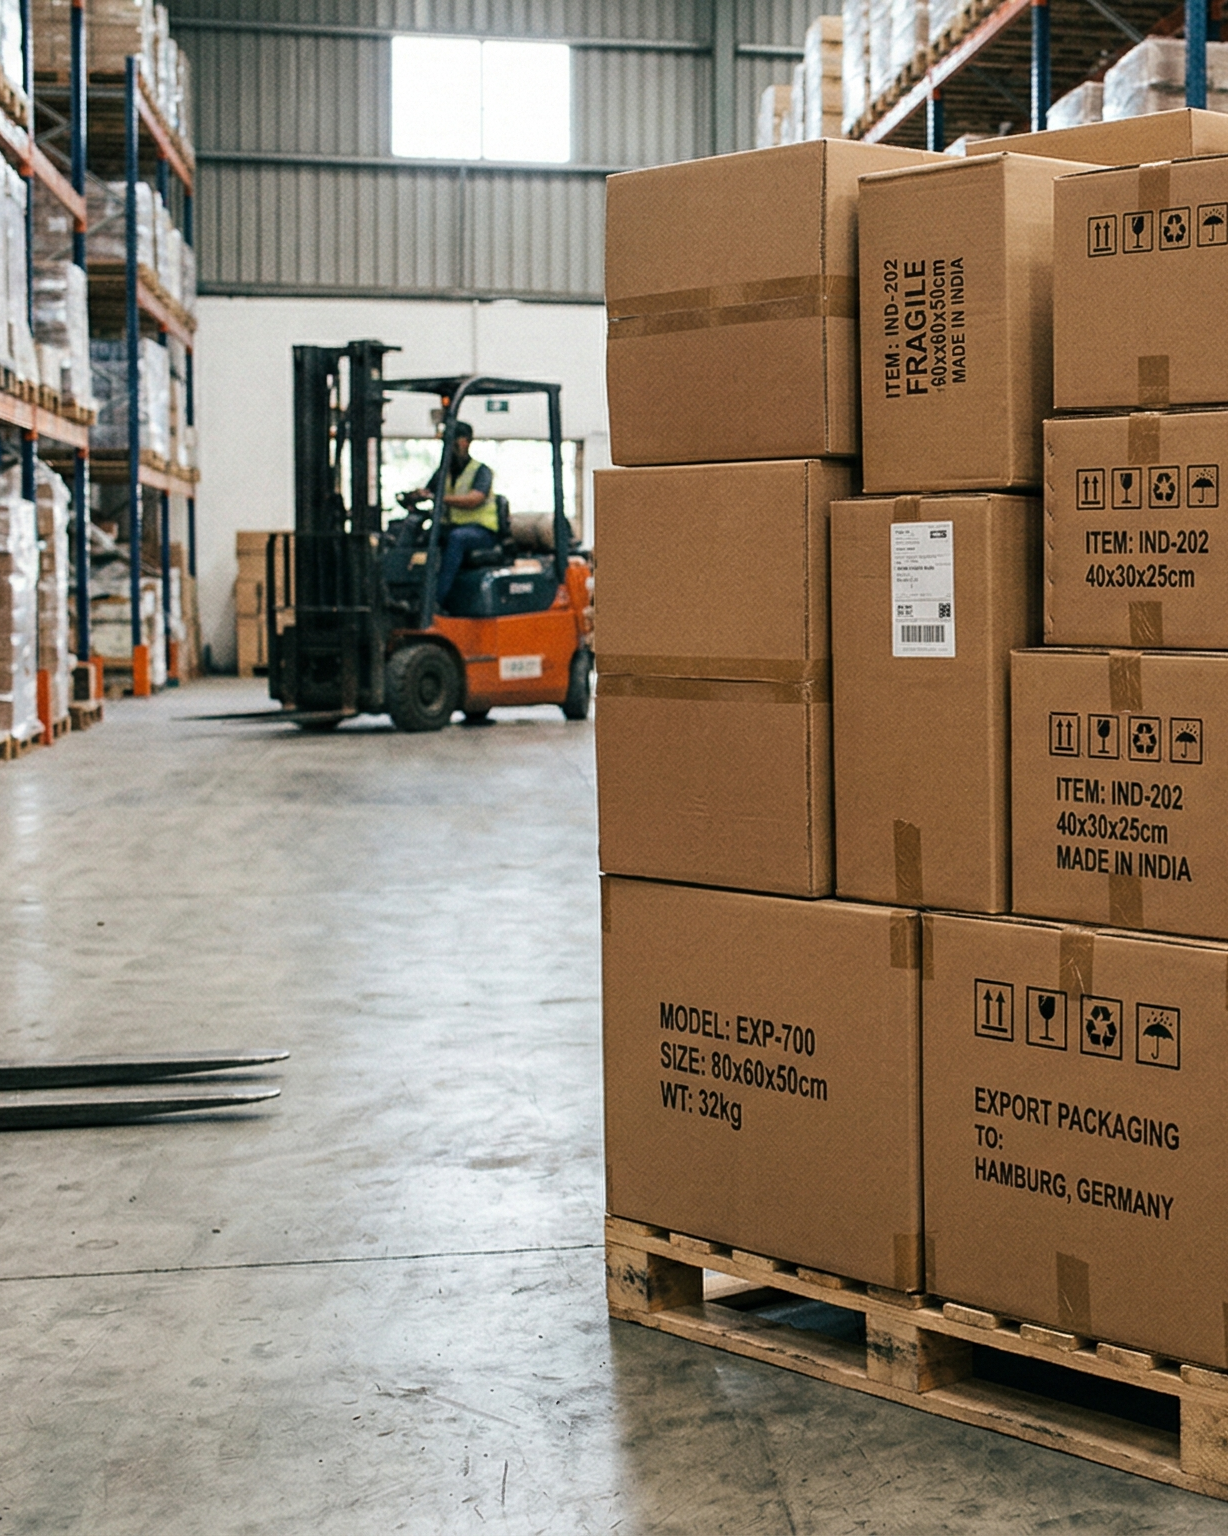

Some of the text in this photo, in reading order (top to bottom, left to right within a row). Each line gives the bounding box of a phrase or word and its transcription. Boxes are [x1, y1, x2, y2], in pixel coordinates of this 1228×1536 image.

[884, 259, 900, 398] ITEM: IND-202
[904, 260, 928, 395] FRAGILE
[950, 257, 966, 383] MADE IN INDIA
[1086, 530, 1209, 554] ITEM: IND-202
[1086, 564, 1194, 587] 40x30x25cm
[1057, 777, 1183, 810] ITEM: IND-202
[1057, 811, 1167, 844] 40x30x25cm
[1057, 845, 1192, 882] MADE IN INDIA
[660, 1002, 815, 1057] MODEL: EXP-700
[661, 1041, 827, 1101] SIZE: 80x60x50cm
[660, 1080, 741, 1131] WT: 32kg
[975, 1087, 1179, 1150] EXPORT PACKAGING
[975, 1124, 1003, 1150] TO:
[975, 1156, 1173, 1220] HAMBURG, GERMANY
